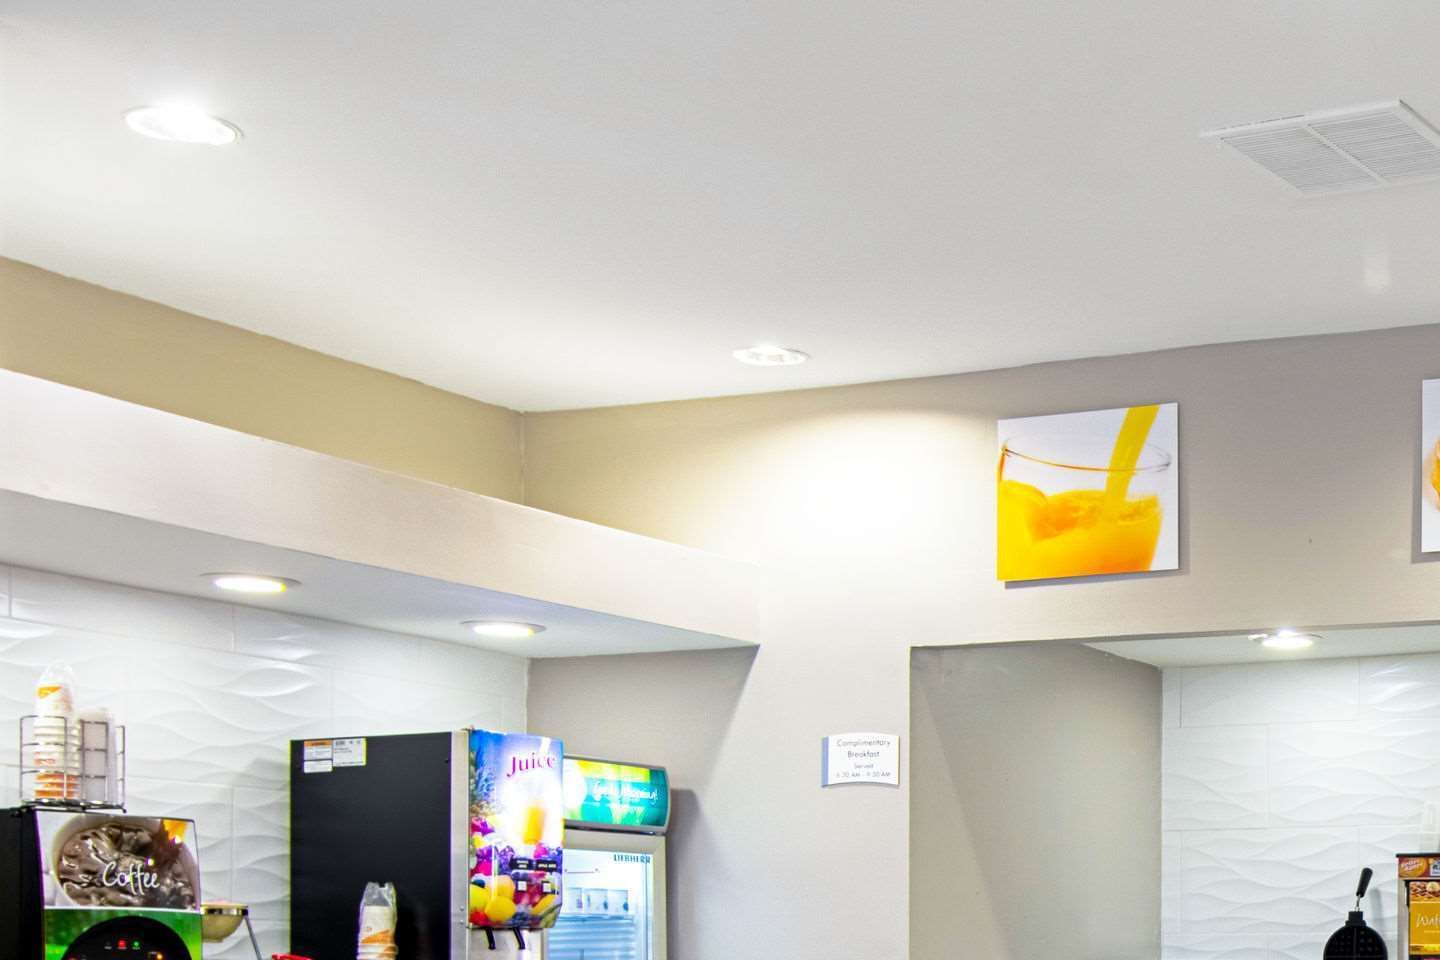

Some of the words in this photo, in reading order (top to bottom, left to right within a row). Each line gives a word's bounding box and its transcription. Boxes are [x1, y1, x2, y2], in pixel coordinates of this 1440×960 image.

[836, 738, 891, 748] Complimentary
[847, 750, 880, 758] Breakfast
[506, 752, 556, 778] Juice
[102, 860, 160, 896] Coffee
